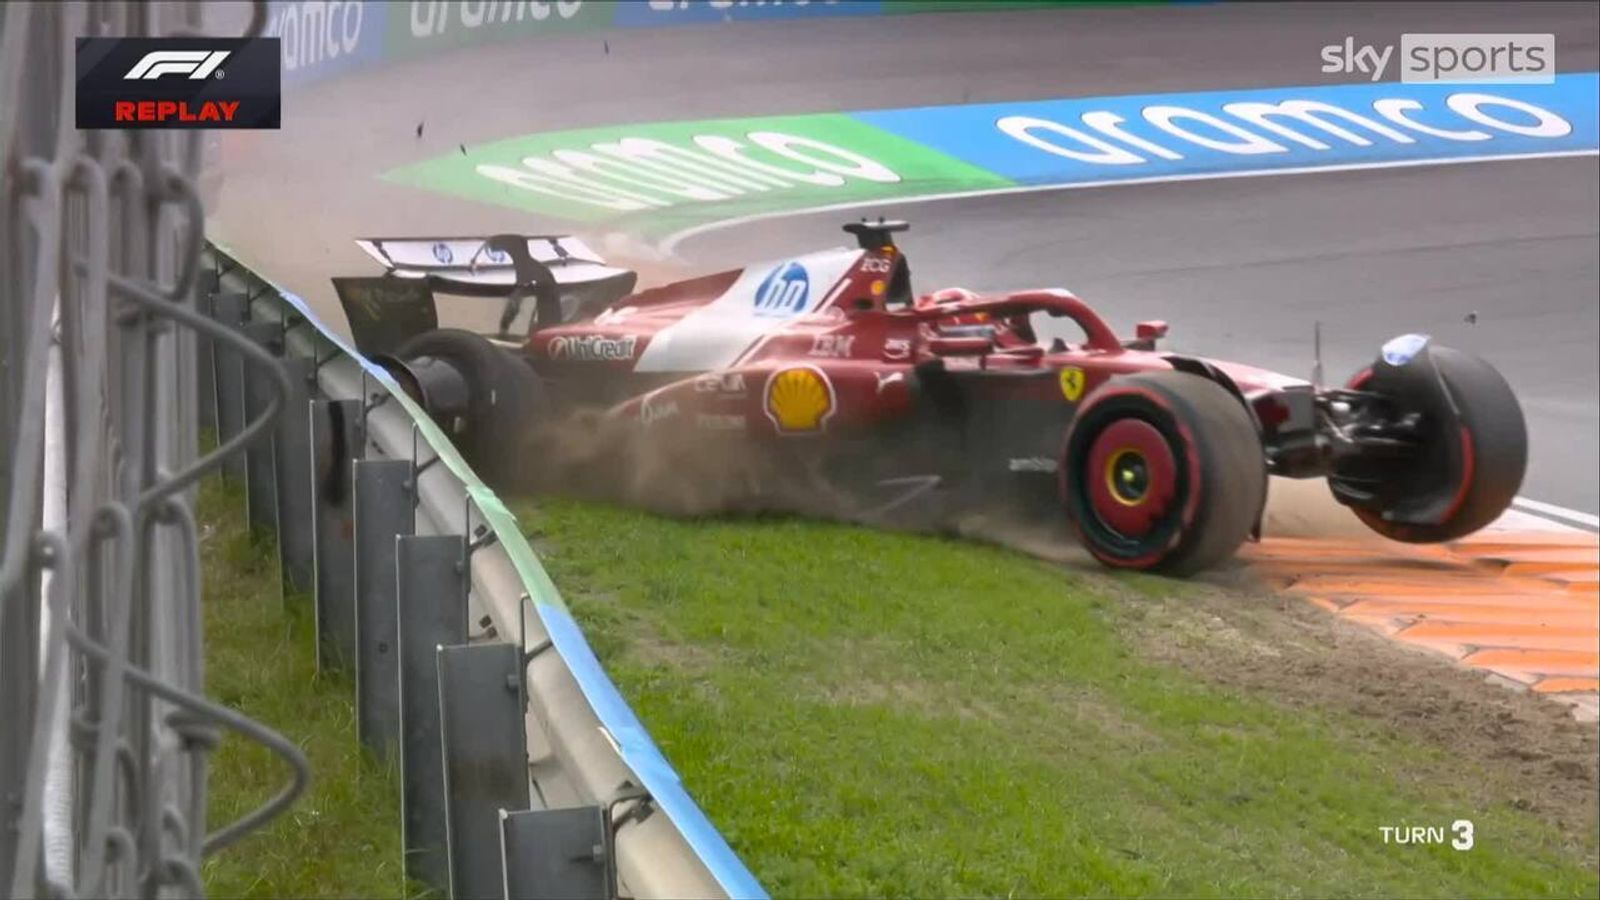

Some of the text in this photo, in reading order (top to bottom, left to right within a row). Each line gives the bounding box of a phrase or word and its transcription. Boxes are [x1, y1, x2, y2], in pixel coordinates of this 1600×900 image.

[264, 1, 363, 70] amco
[997, 93, 1572, 165] aramco
[476, 131, 901, 210] aramco
[755, 261, 809, 315] hp
